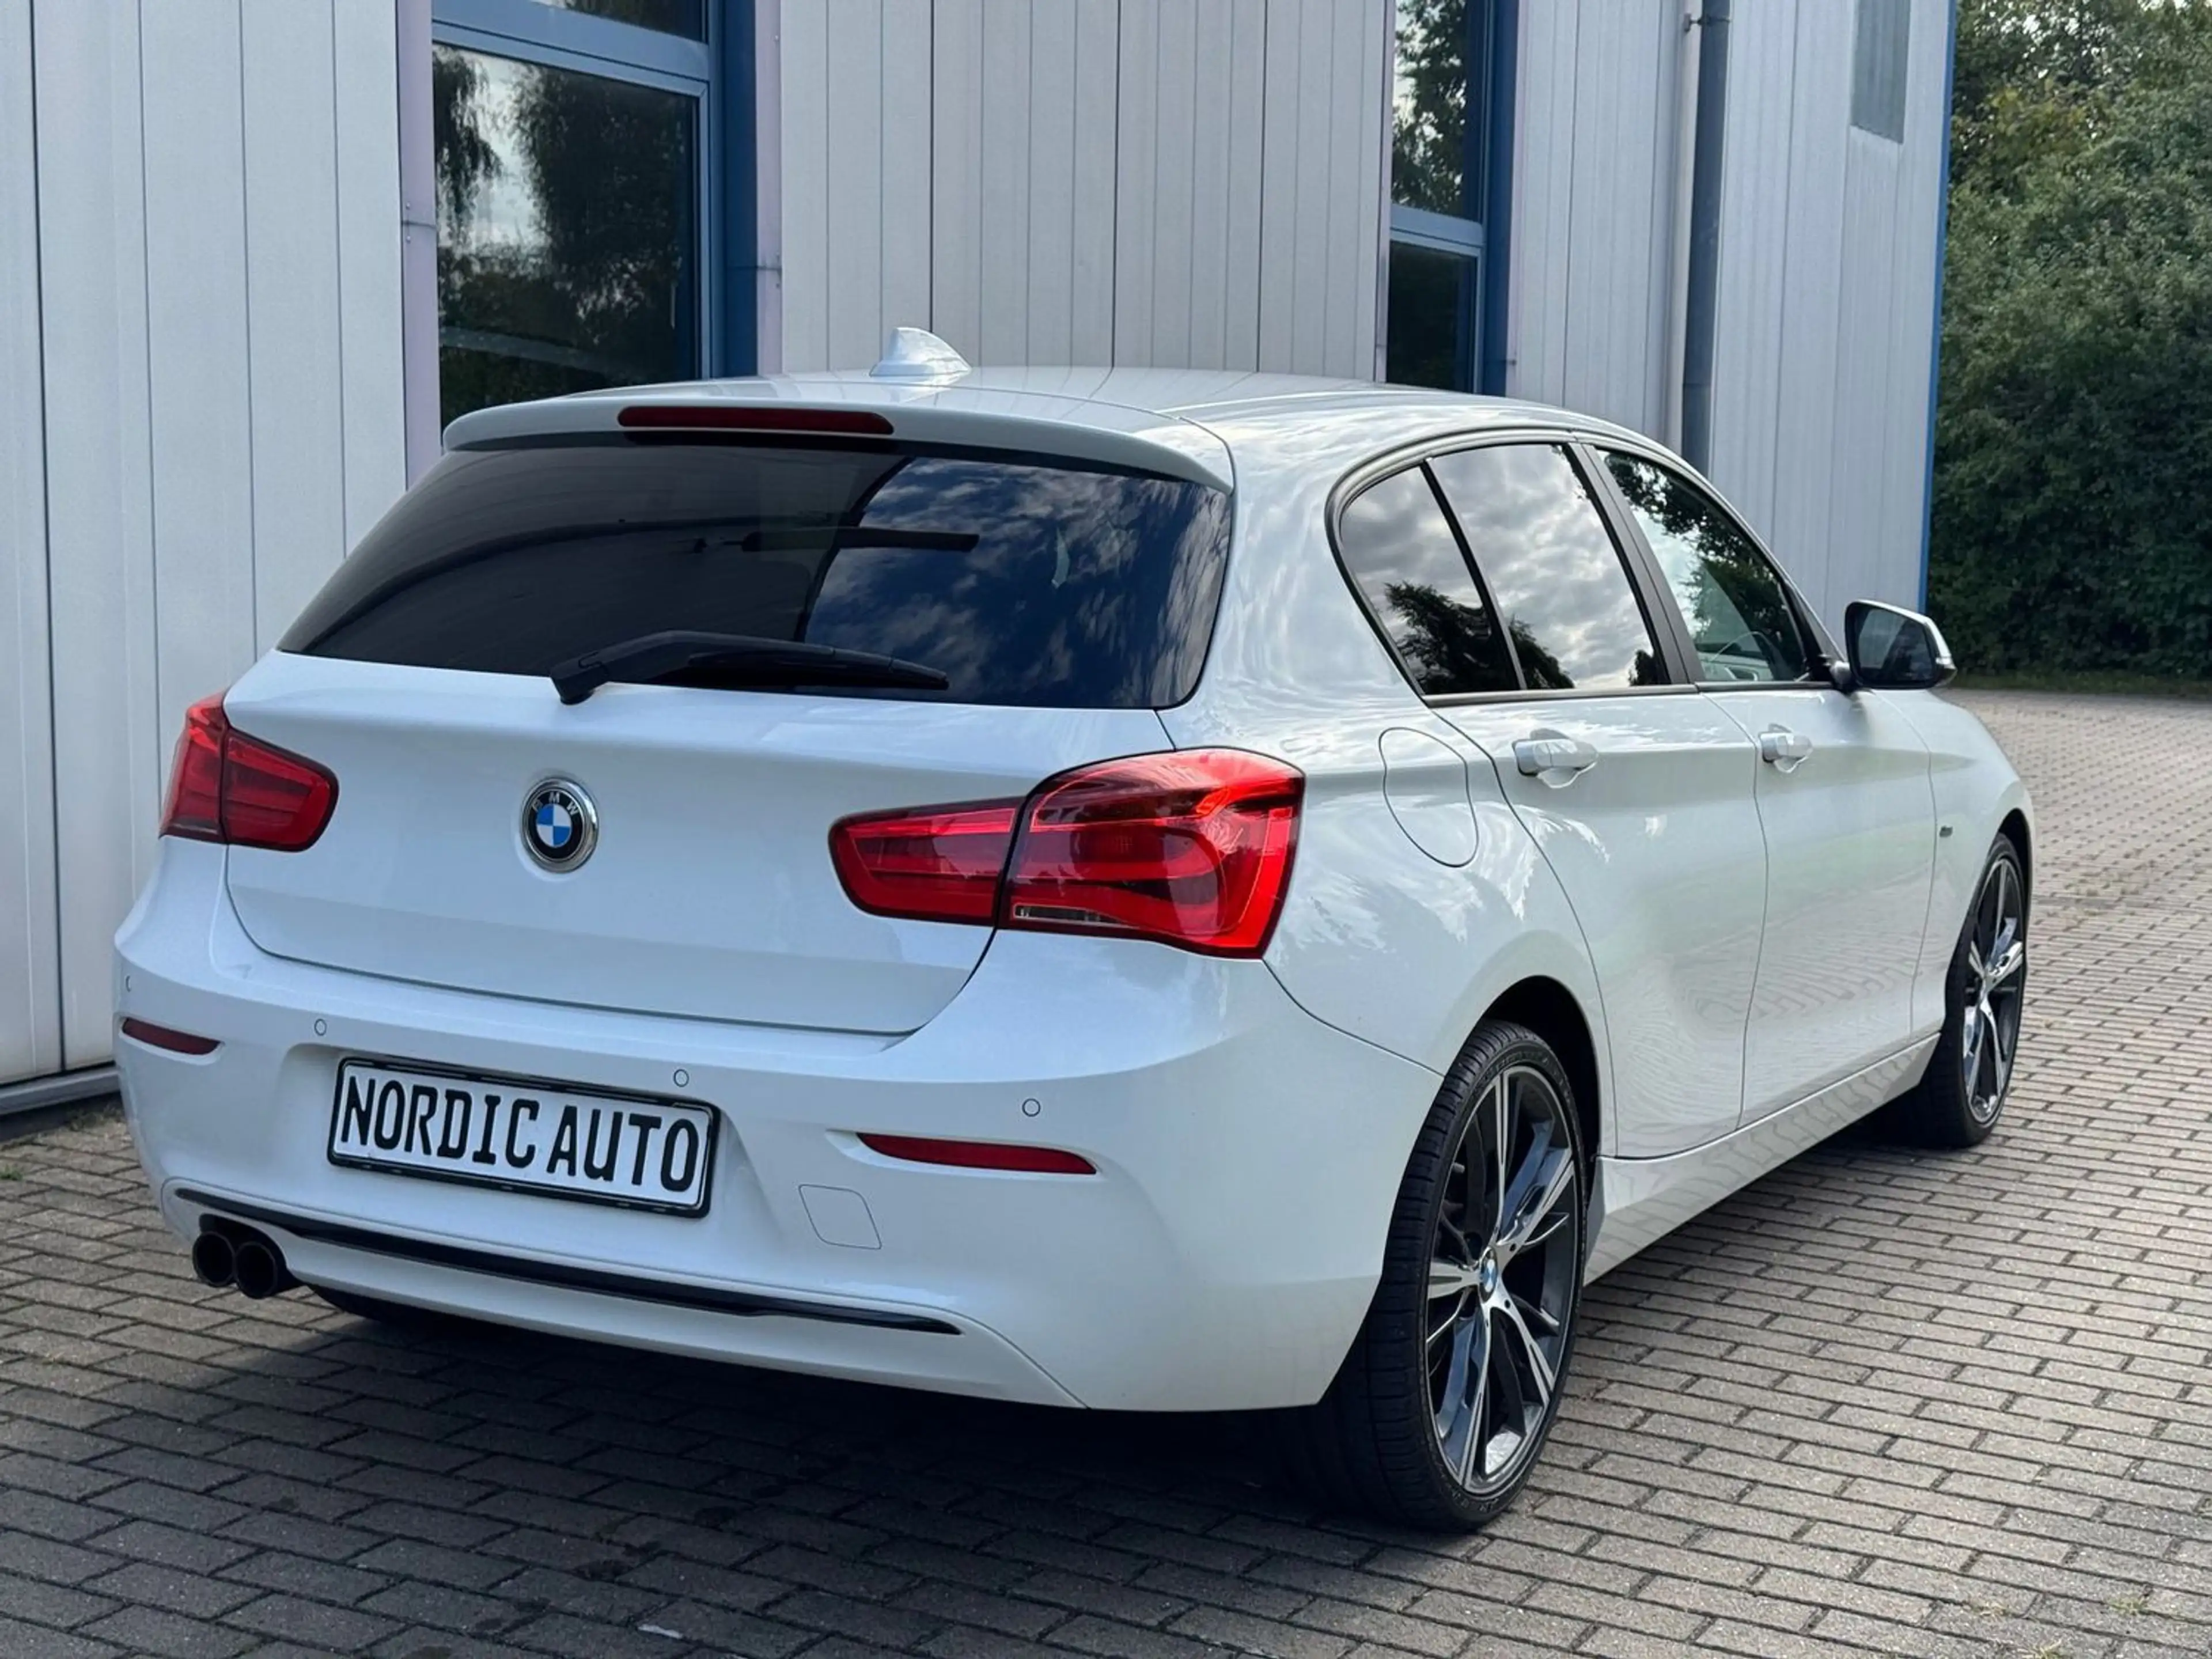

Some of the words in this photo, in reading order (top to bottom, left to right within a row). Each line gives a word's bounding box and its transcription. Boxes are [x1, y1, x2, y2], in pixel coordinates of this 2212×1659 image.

[532, 791, 579, 815] BMW
[341, 1076, 540, 1168] NORDIC
[546, 1105, 699, 1192] AUTO
